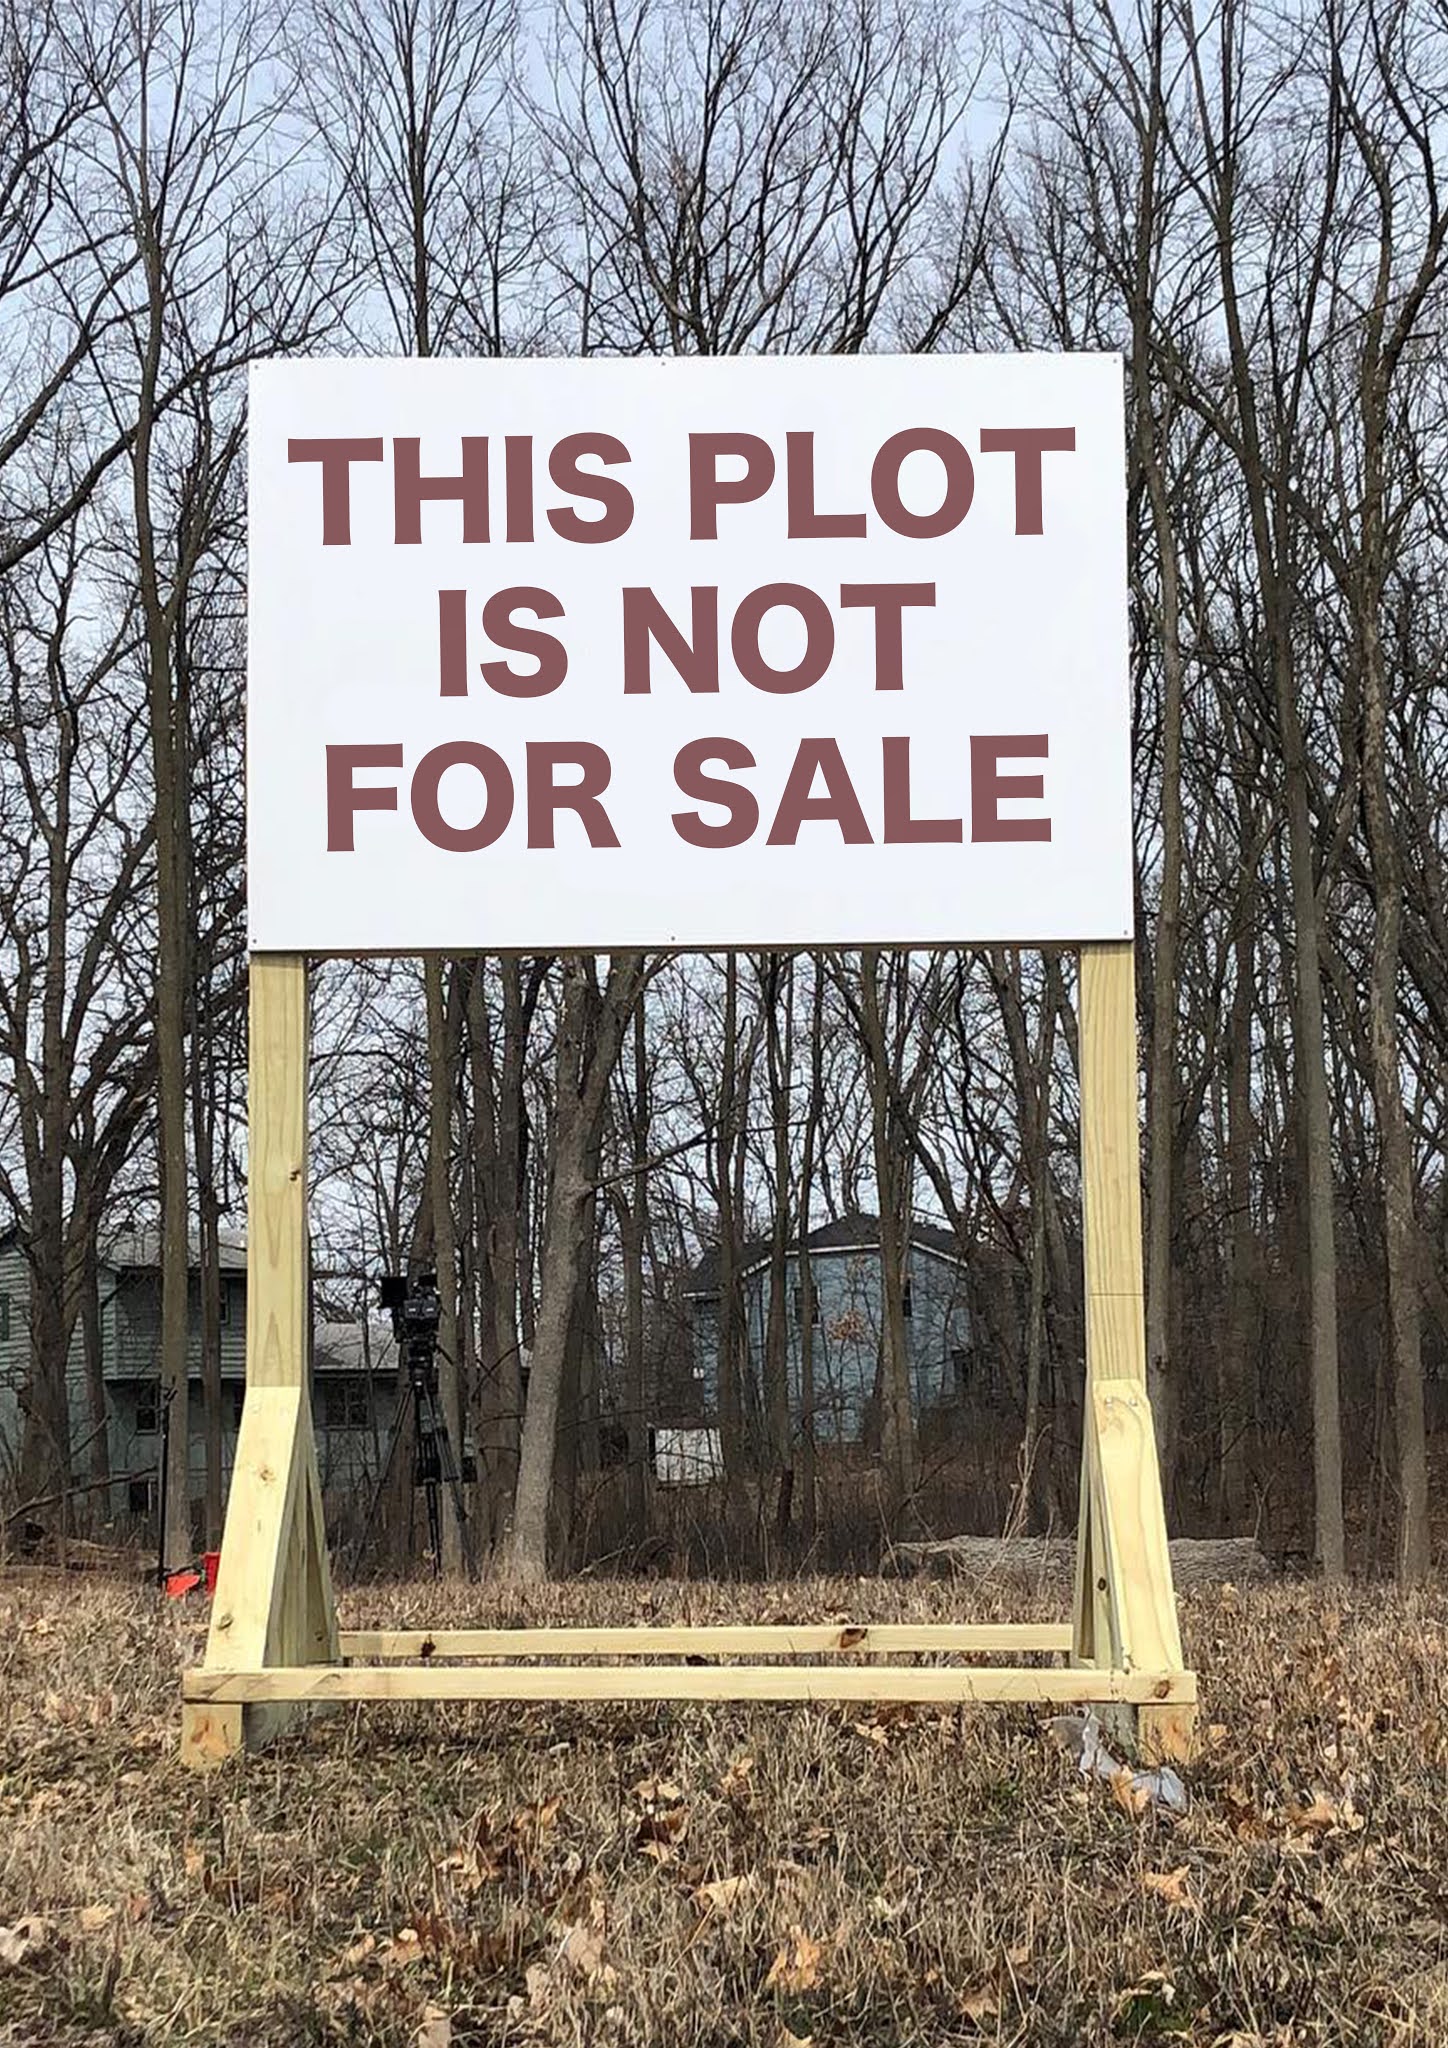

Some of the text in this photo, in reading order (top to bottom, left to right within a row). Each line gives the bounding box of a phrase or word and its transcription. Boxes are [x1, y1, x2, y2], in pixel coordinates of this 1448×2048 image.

[288, 427, 1076, 545] THIS PLOT
[439, 582, 936, 698] IS NOT
[326, 734, 1052, 852] FOR SALE
